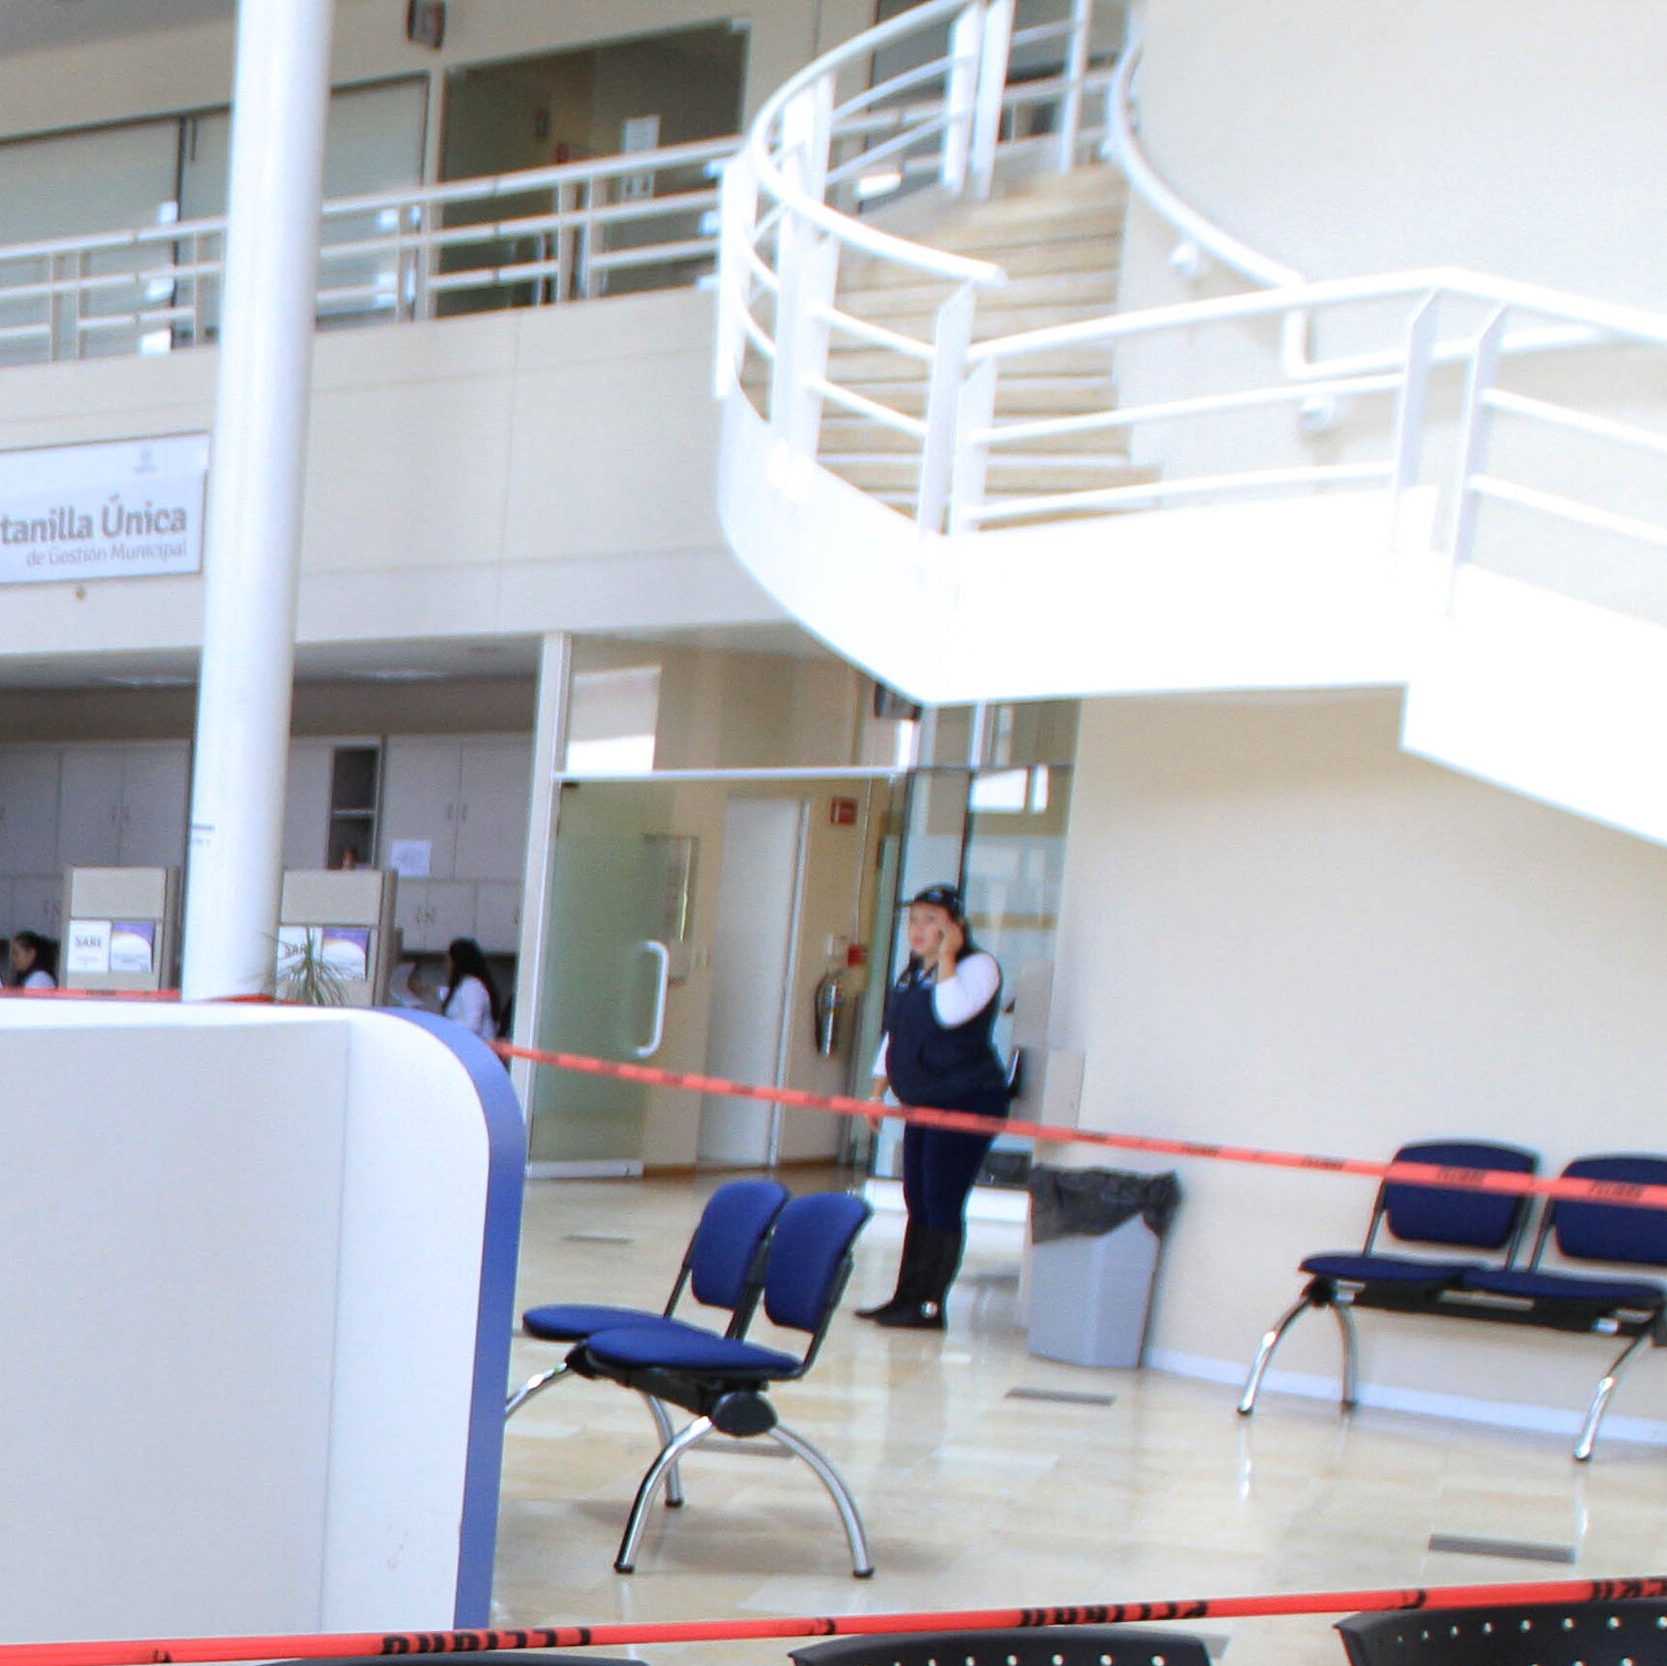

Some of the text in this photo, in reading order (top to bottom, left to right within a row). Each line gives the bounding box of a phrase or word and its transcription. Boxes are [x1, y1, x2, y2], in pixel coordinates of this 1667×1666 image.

[101, 493, 187, 539] Única
[26, 539, 188, 567] de Gestión Municipal
